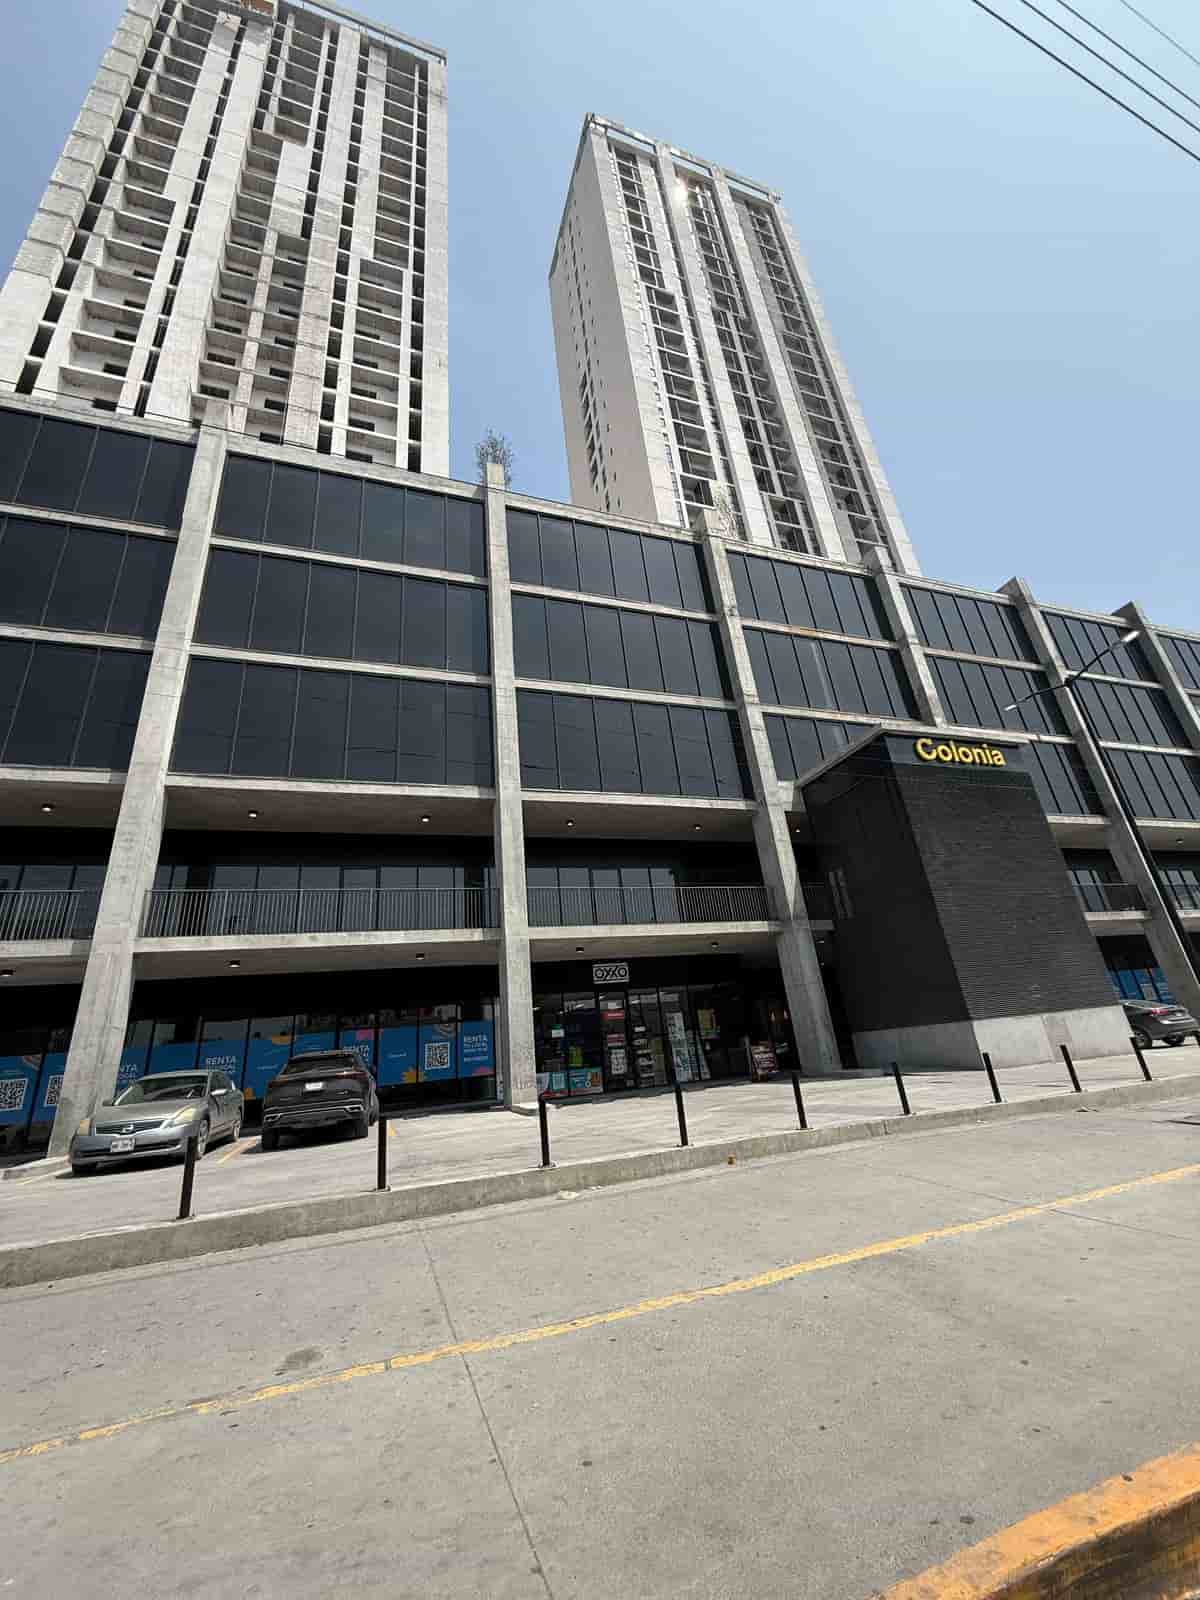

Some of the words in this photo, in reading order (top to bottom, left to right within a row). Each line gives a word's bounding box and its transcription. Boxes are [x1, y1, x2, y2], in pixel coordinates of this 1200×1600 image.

[915, 738, 1007, 767] Colonia
[594, 966, 628, 981] OXXO
[207, 1056, 236, 1065] RENTA
